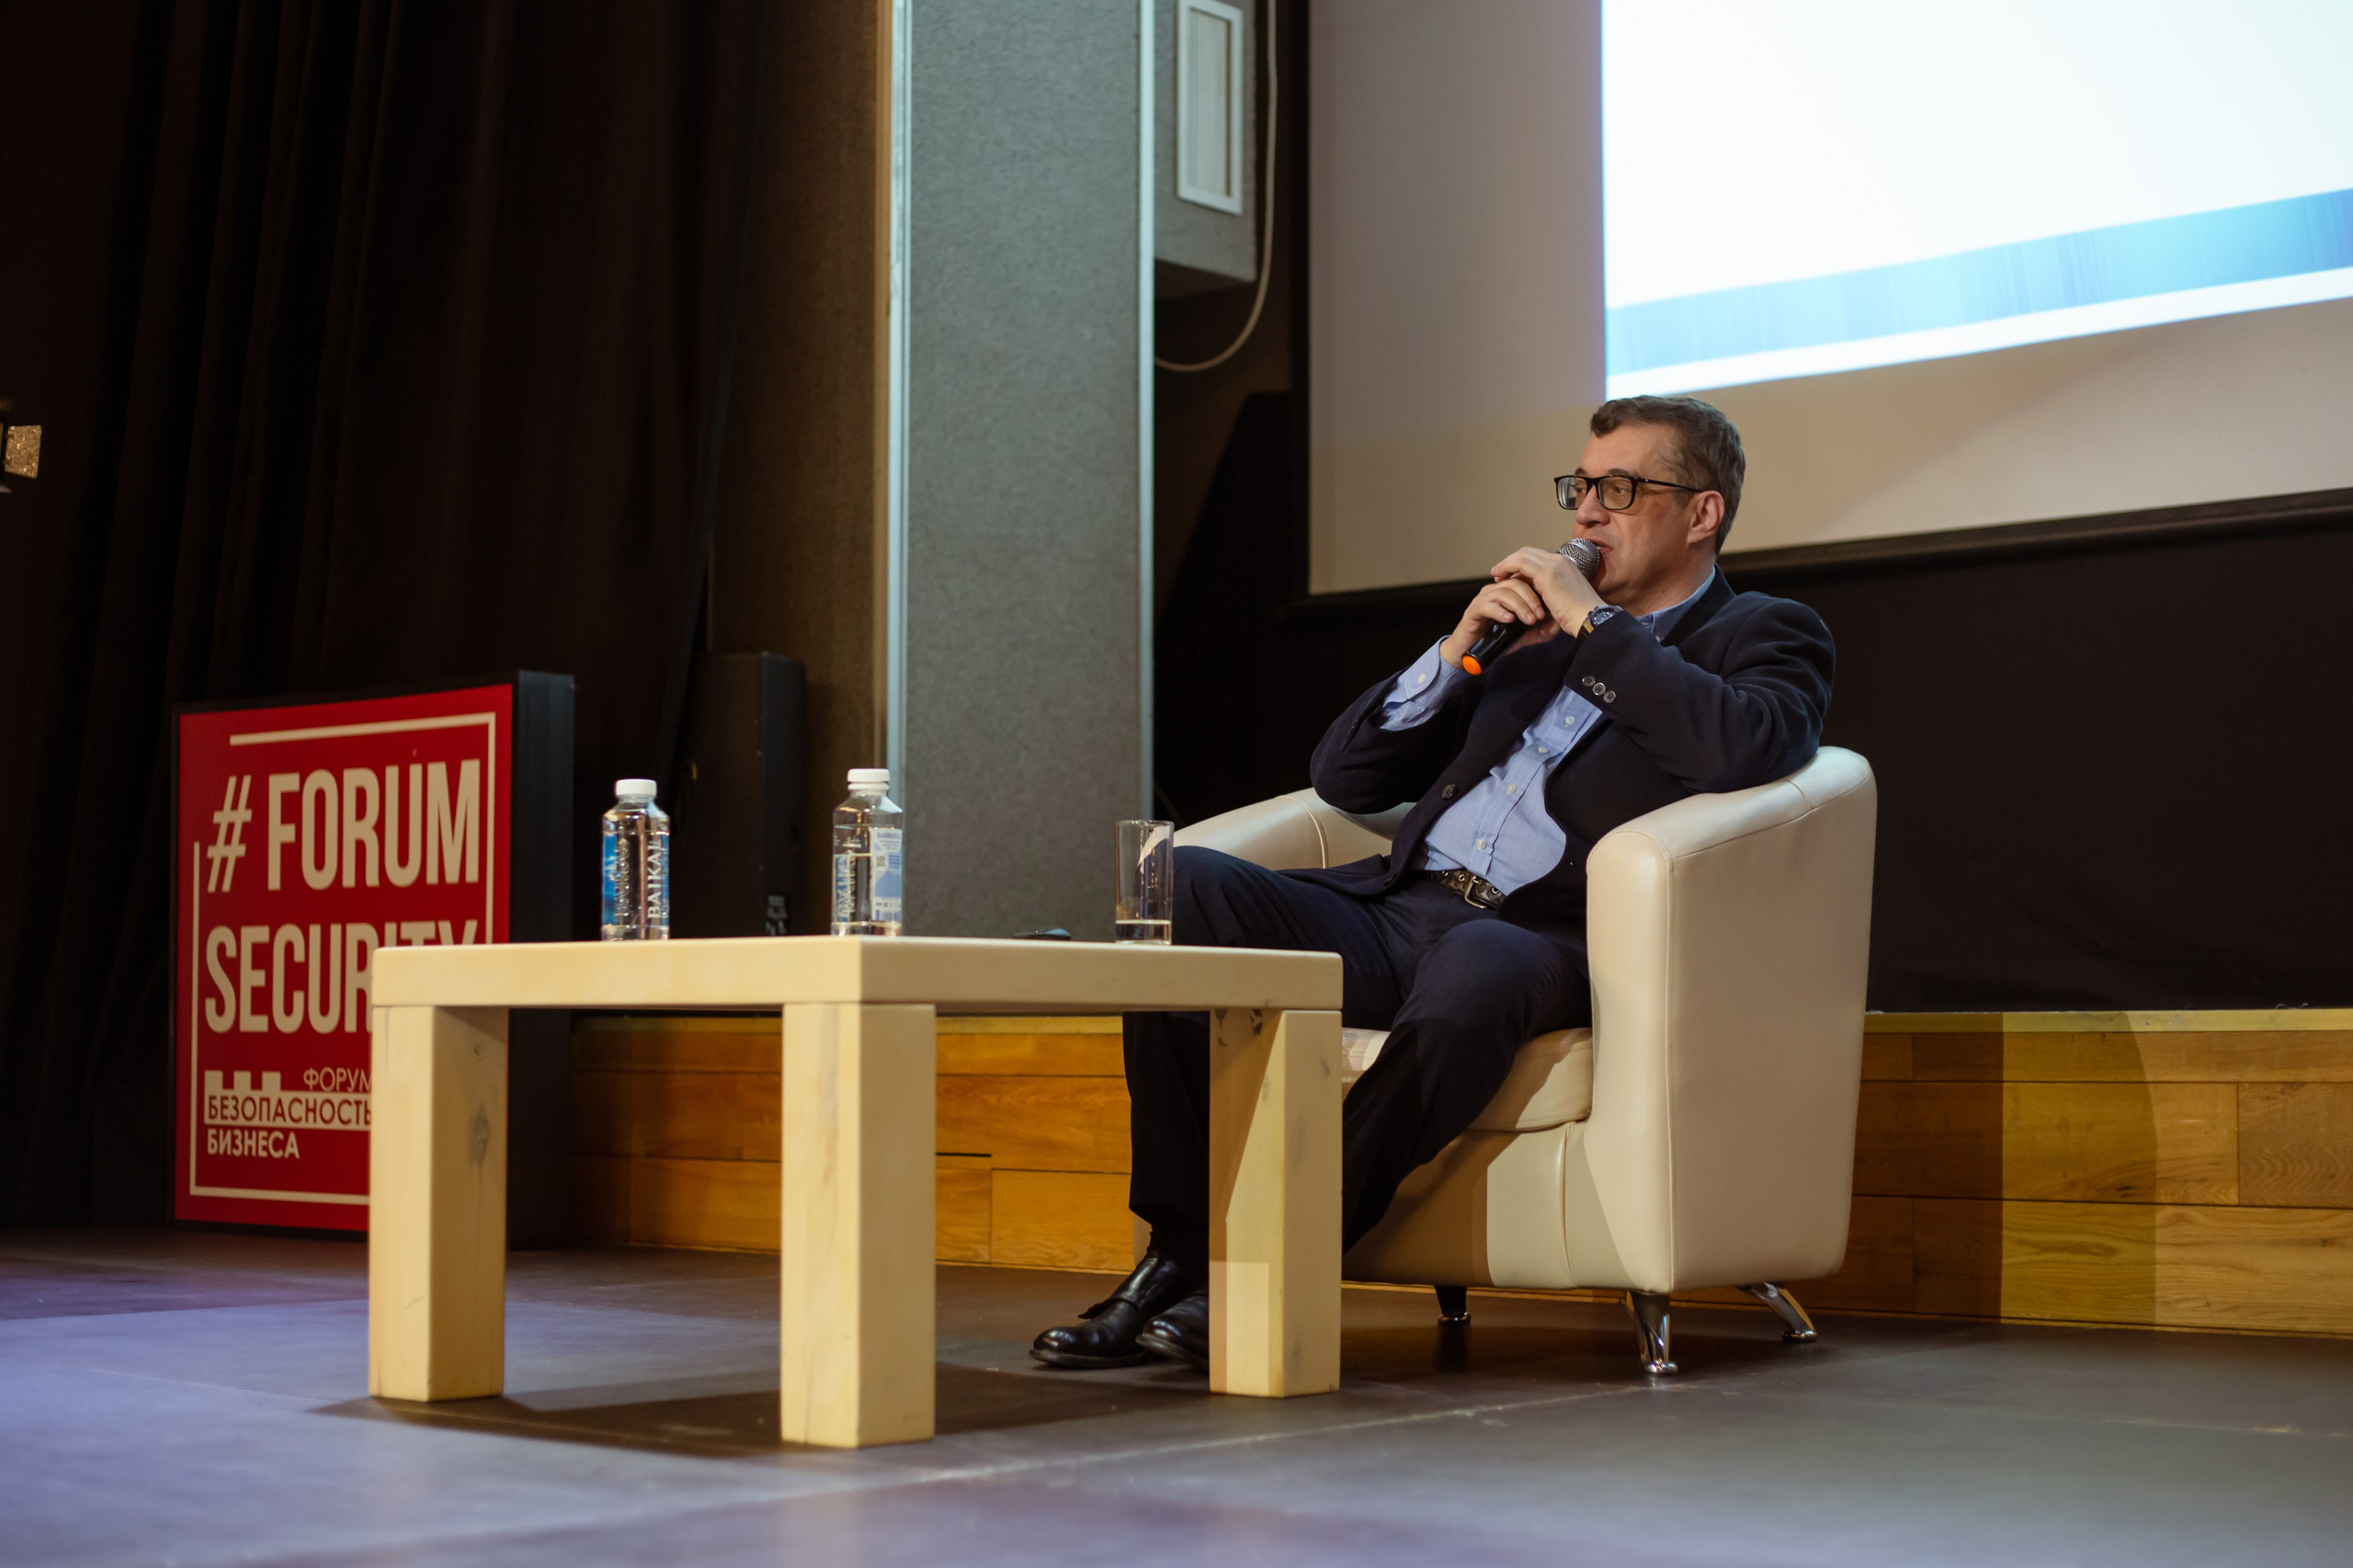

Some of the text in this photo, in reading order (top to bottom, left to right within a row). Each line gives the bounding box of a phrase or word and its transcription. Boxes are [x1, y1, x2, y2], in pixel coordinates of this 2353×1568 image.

[267, 758, 480, 891] FORUM
[647, 840, 662, 918] BAIKAL
[205, 919, 478, 1034] SECUR
[207, 1128, 301, 1160] БИЗНЕСА
